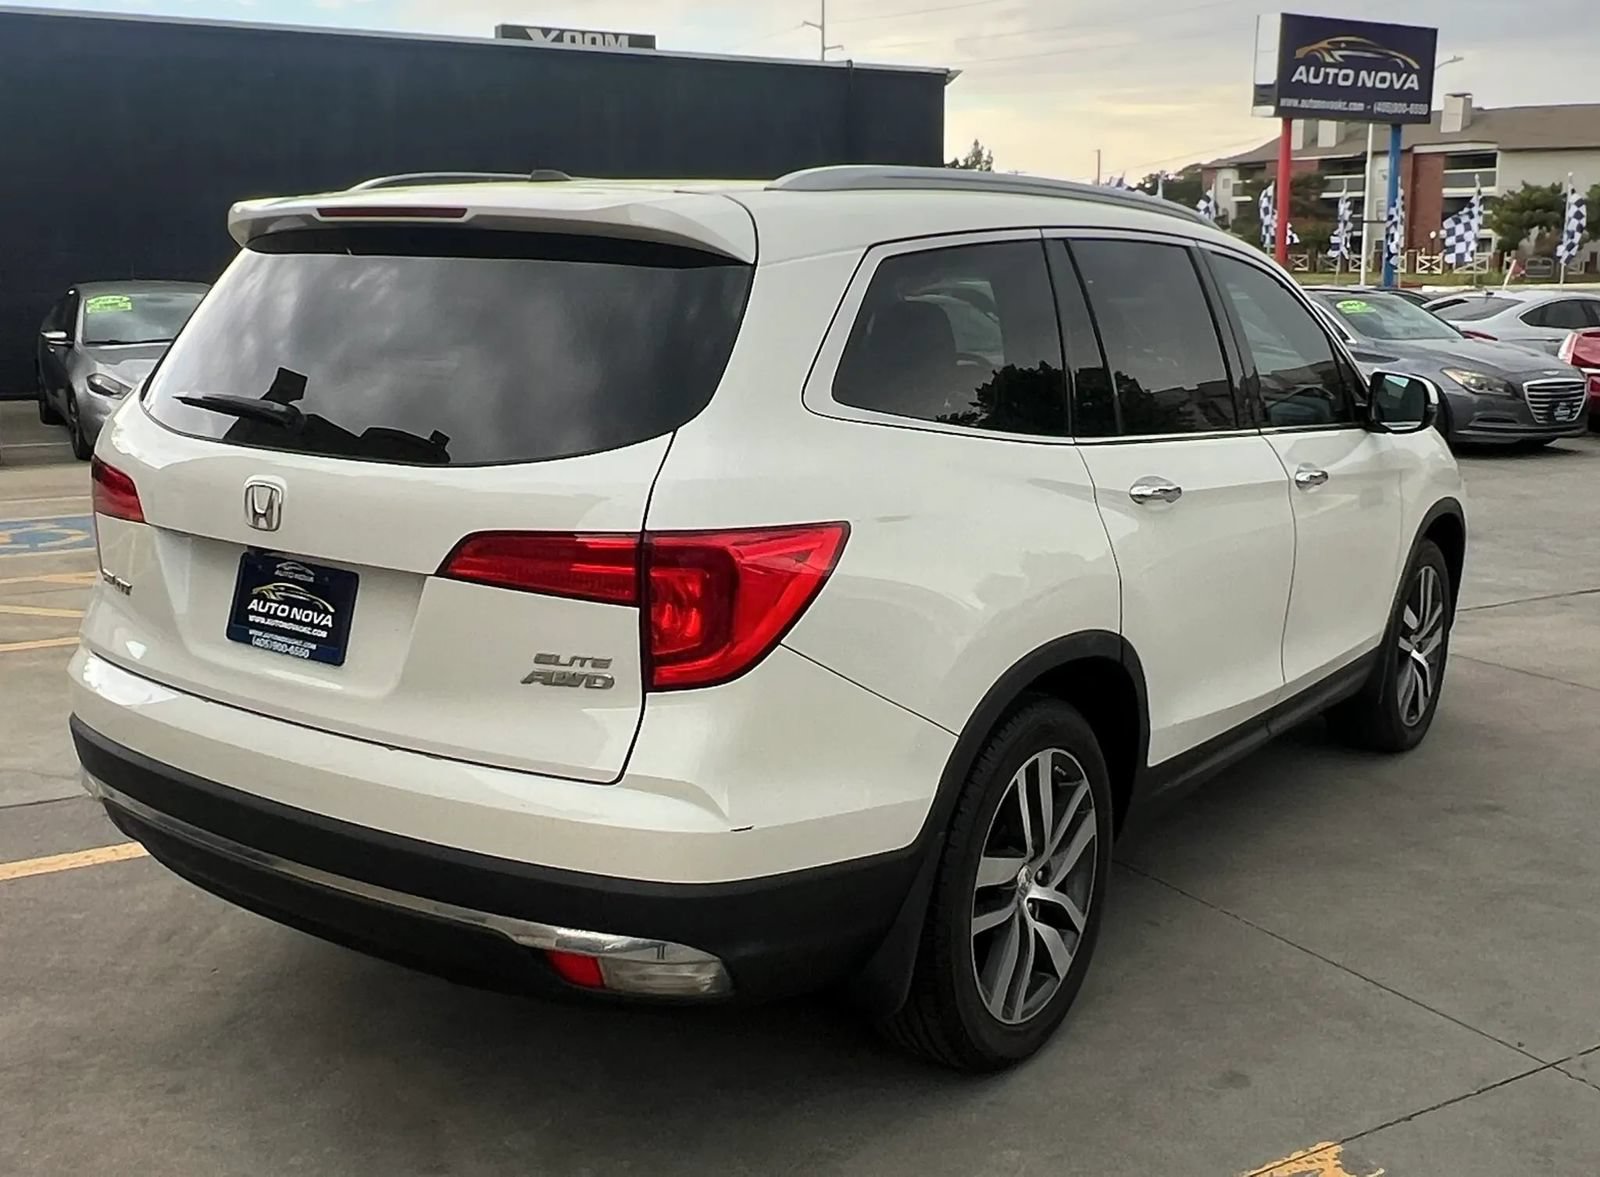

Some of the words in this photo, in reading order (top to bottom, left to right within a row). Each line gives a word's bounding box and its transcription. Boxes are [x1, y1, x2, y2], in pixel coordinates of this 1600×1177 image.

[1291, 65, 1355, 86] AUTO
[1357, 70, 1420, 91] NOVA
[247, 598, 289, 617] AUTO
[290, 607, 334, 628] NOVA
[533, 653, 613, 669] ELITE
[520, 670, 615, 690] AWD
